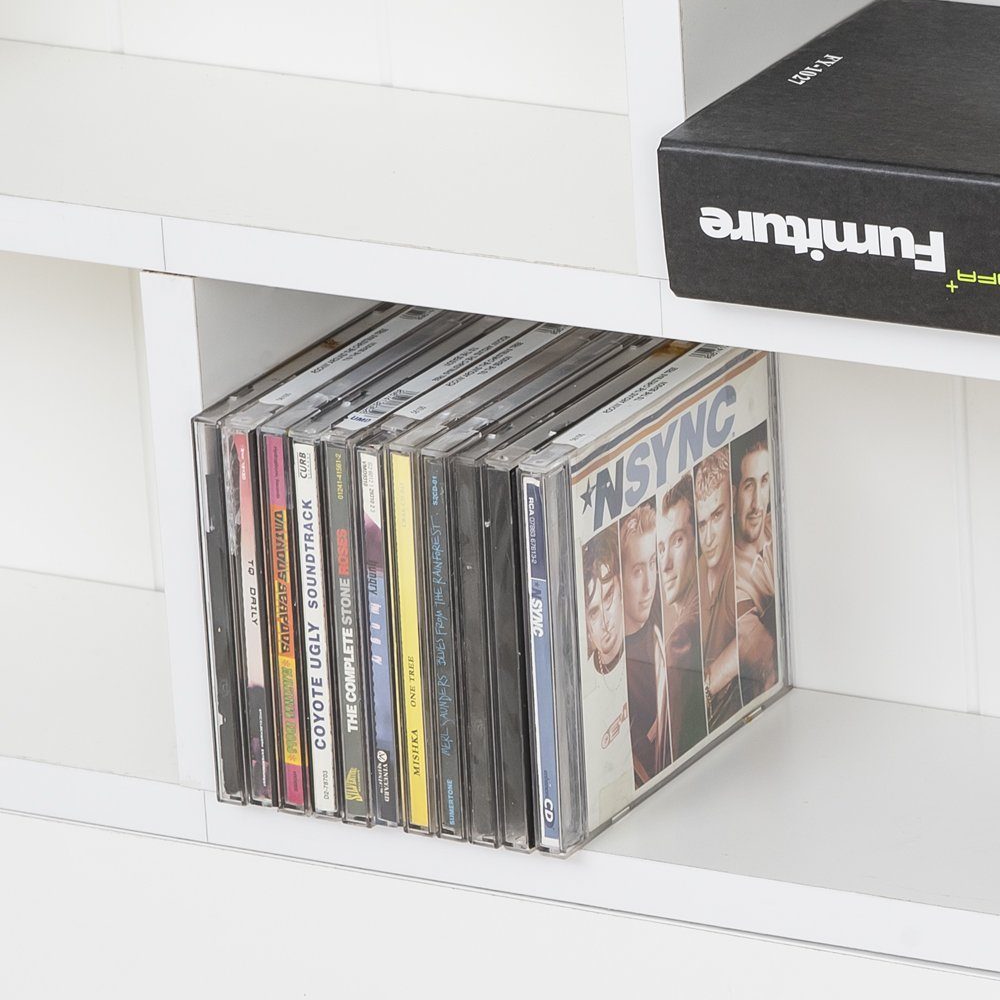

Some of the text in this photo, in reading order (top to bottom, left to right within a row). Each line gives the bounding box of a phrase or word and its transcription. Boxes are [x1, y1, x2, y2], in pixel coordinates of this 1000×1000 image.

[787, 53, 844, 86] FY-1027
[699, 206, 947, 273] Furniture
[299, 452, 308, 479] CURB
[247, 559, 259, 626] TQ DAILY
[301, 499, 327, 750] COYOTE UGLY SOUNDTRACK
[336, 528, 359, 733] THE COMPLETE STONE ROSES
[408, 655, 416, 686] TREE
[413, 729, 421, 777] MISHKA
[544, 798, 553, 823] CD
